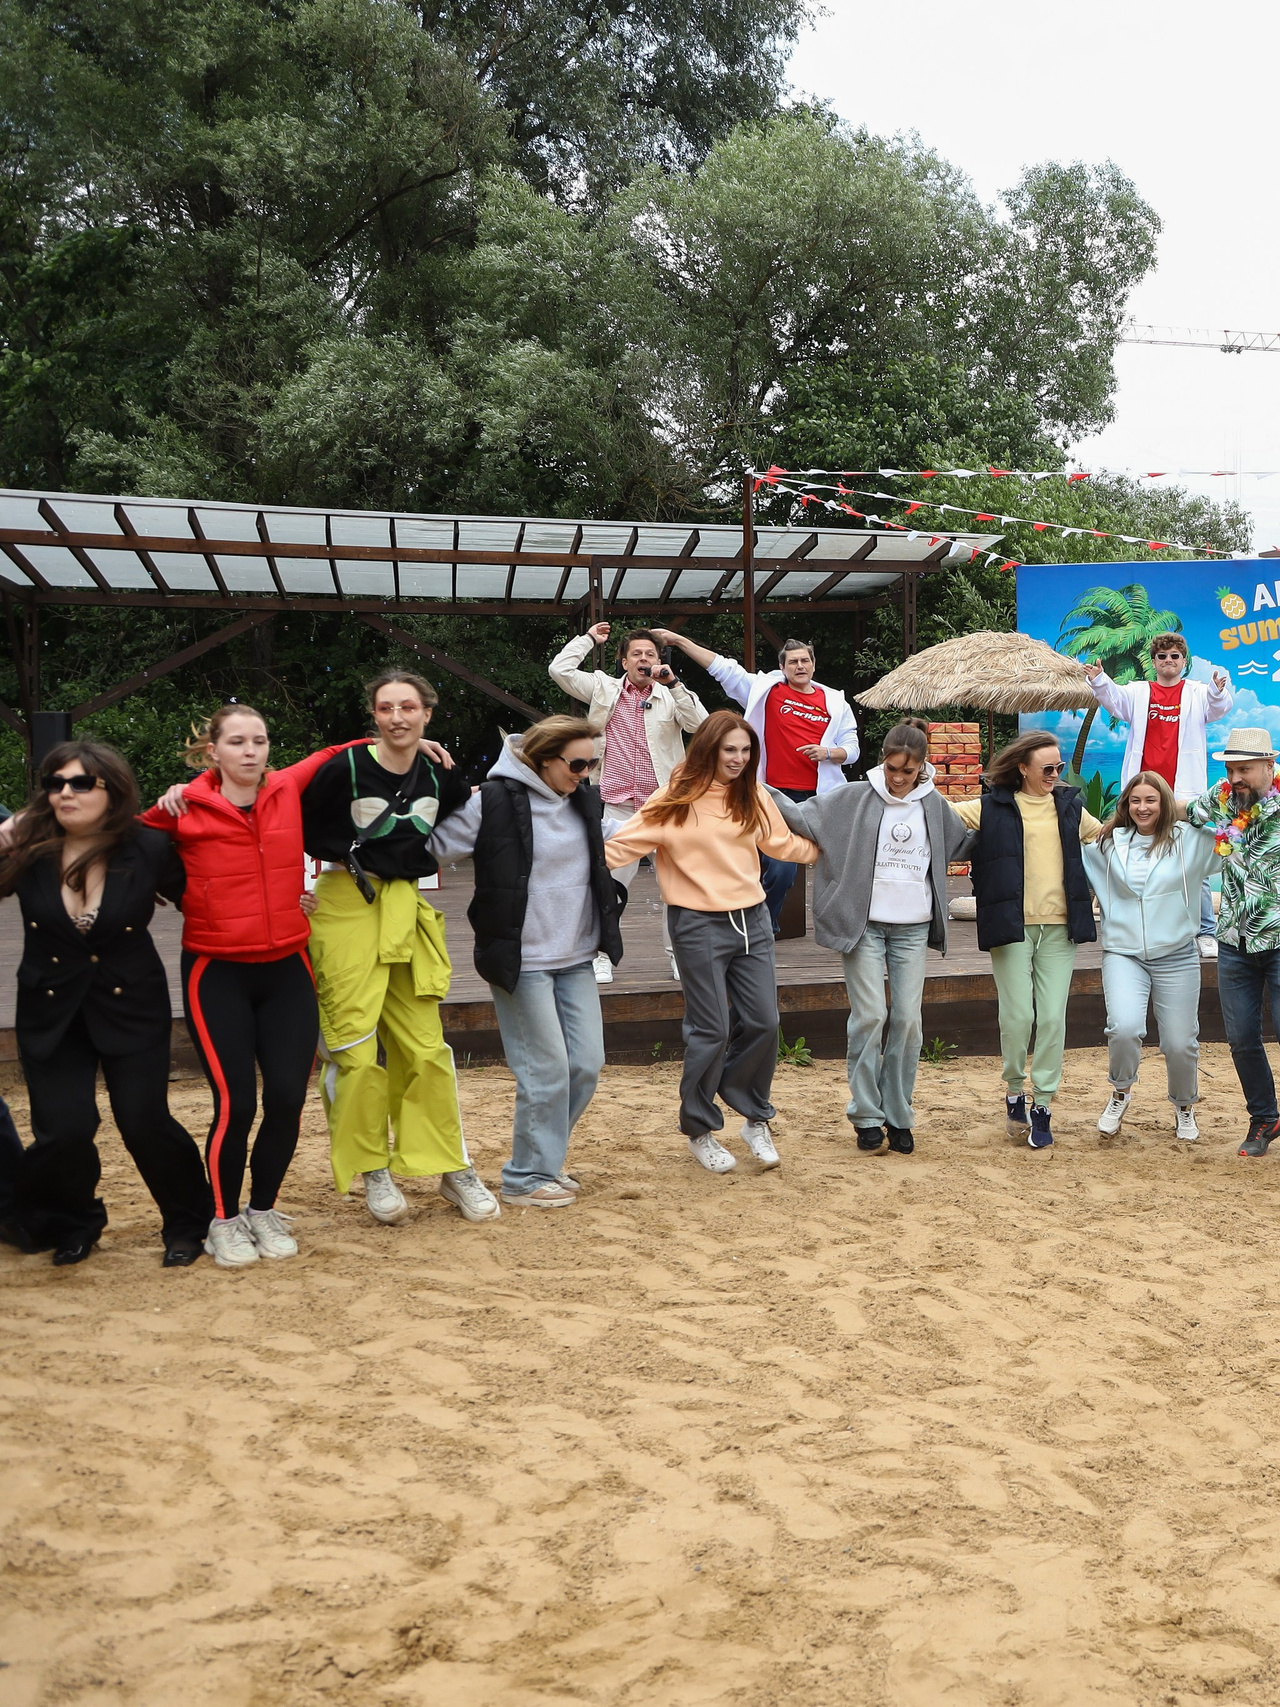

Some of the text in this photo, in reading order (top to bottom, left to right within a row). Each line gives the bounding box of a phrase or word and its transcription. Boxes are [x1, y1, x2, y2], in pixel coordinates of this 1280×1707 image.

[792, 710, 829, 723] arlight
[1158, 714, 1180, 722] arlig
[883, 842, 915, 856] Original
